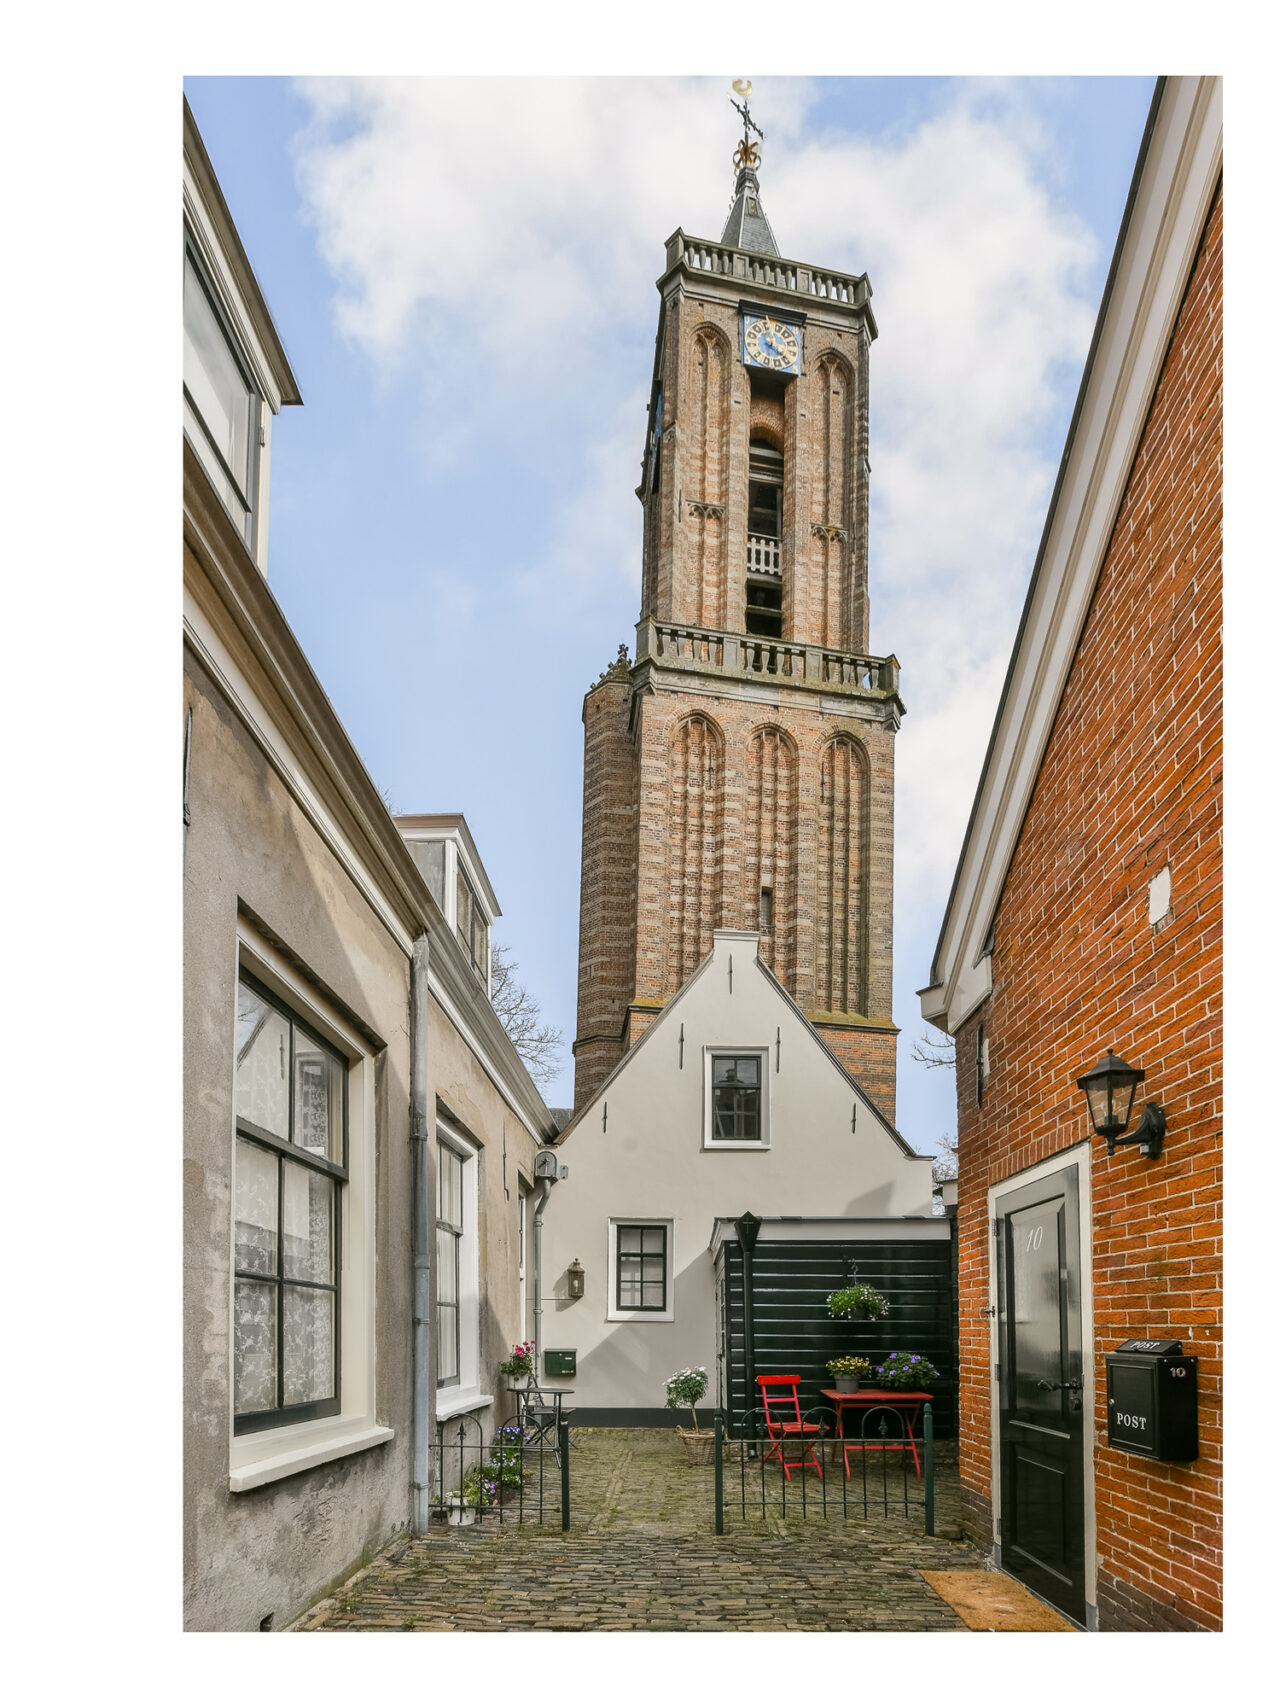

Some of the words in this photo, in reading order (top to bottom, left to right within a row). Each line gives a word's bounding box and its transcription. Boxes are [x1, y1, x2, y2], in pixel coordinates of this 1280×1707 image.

[1026, 1225, 1043, 1252] 10
[1129, 1341, 1160, 1350] POST
[1169, 1367, 1186, 1378] 10
[1116, 1412, 1147, 1430] POST
